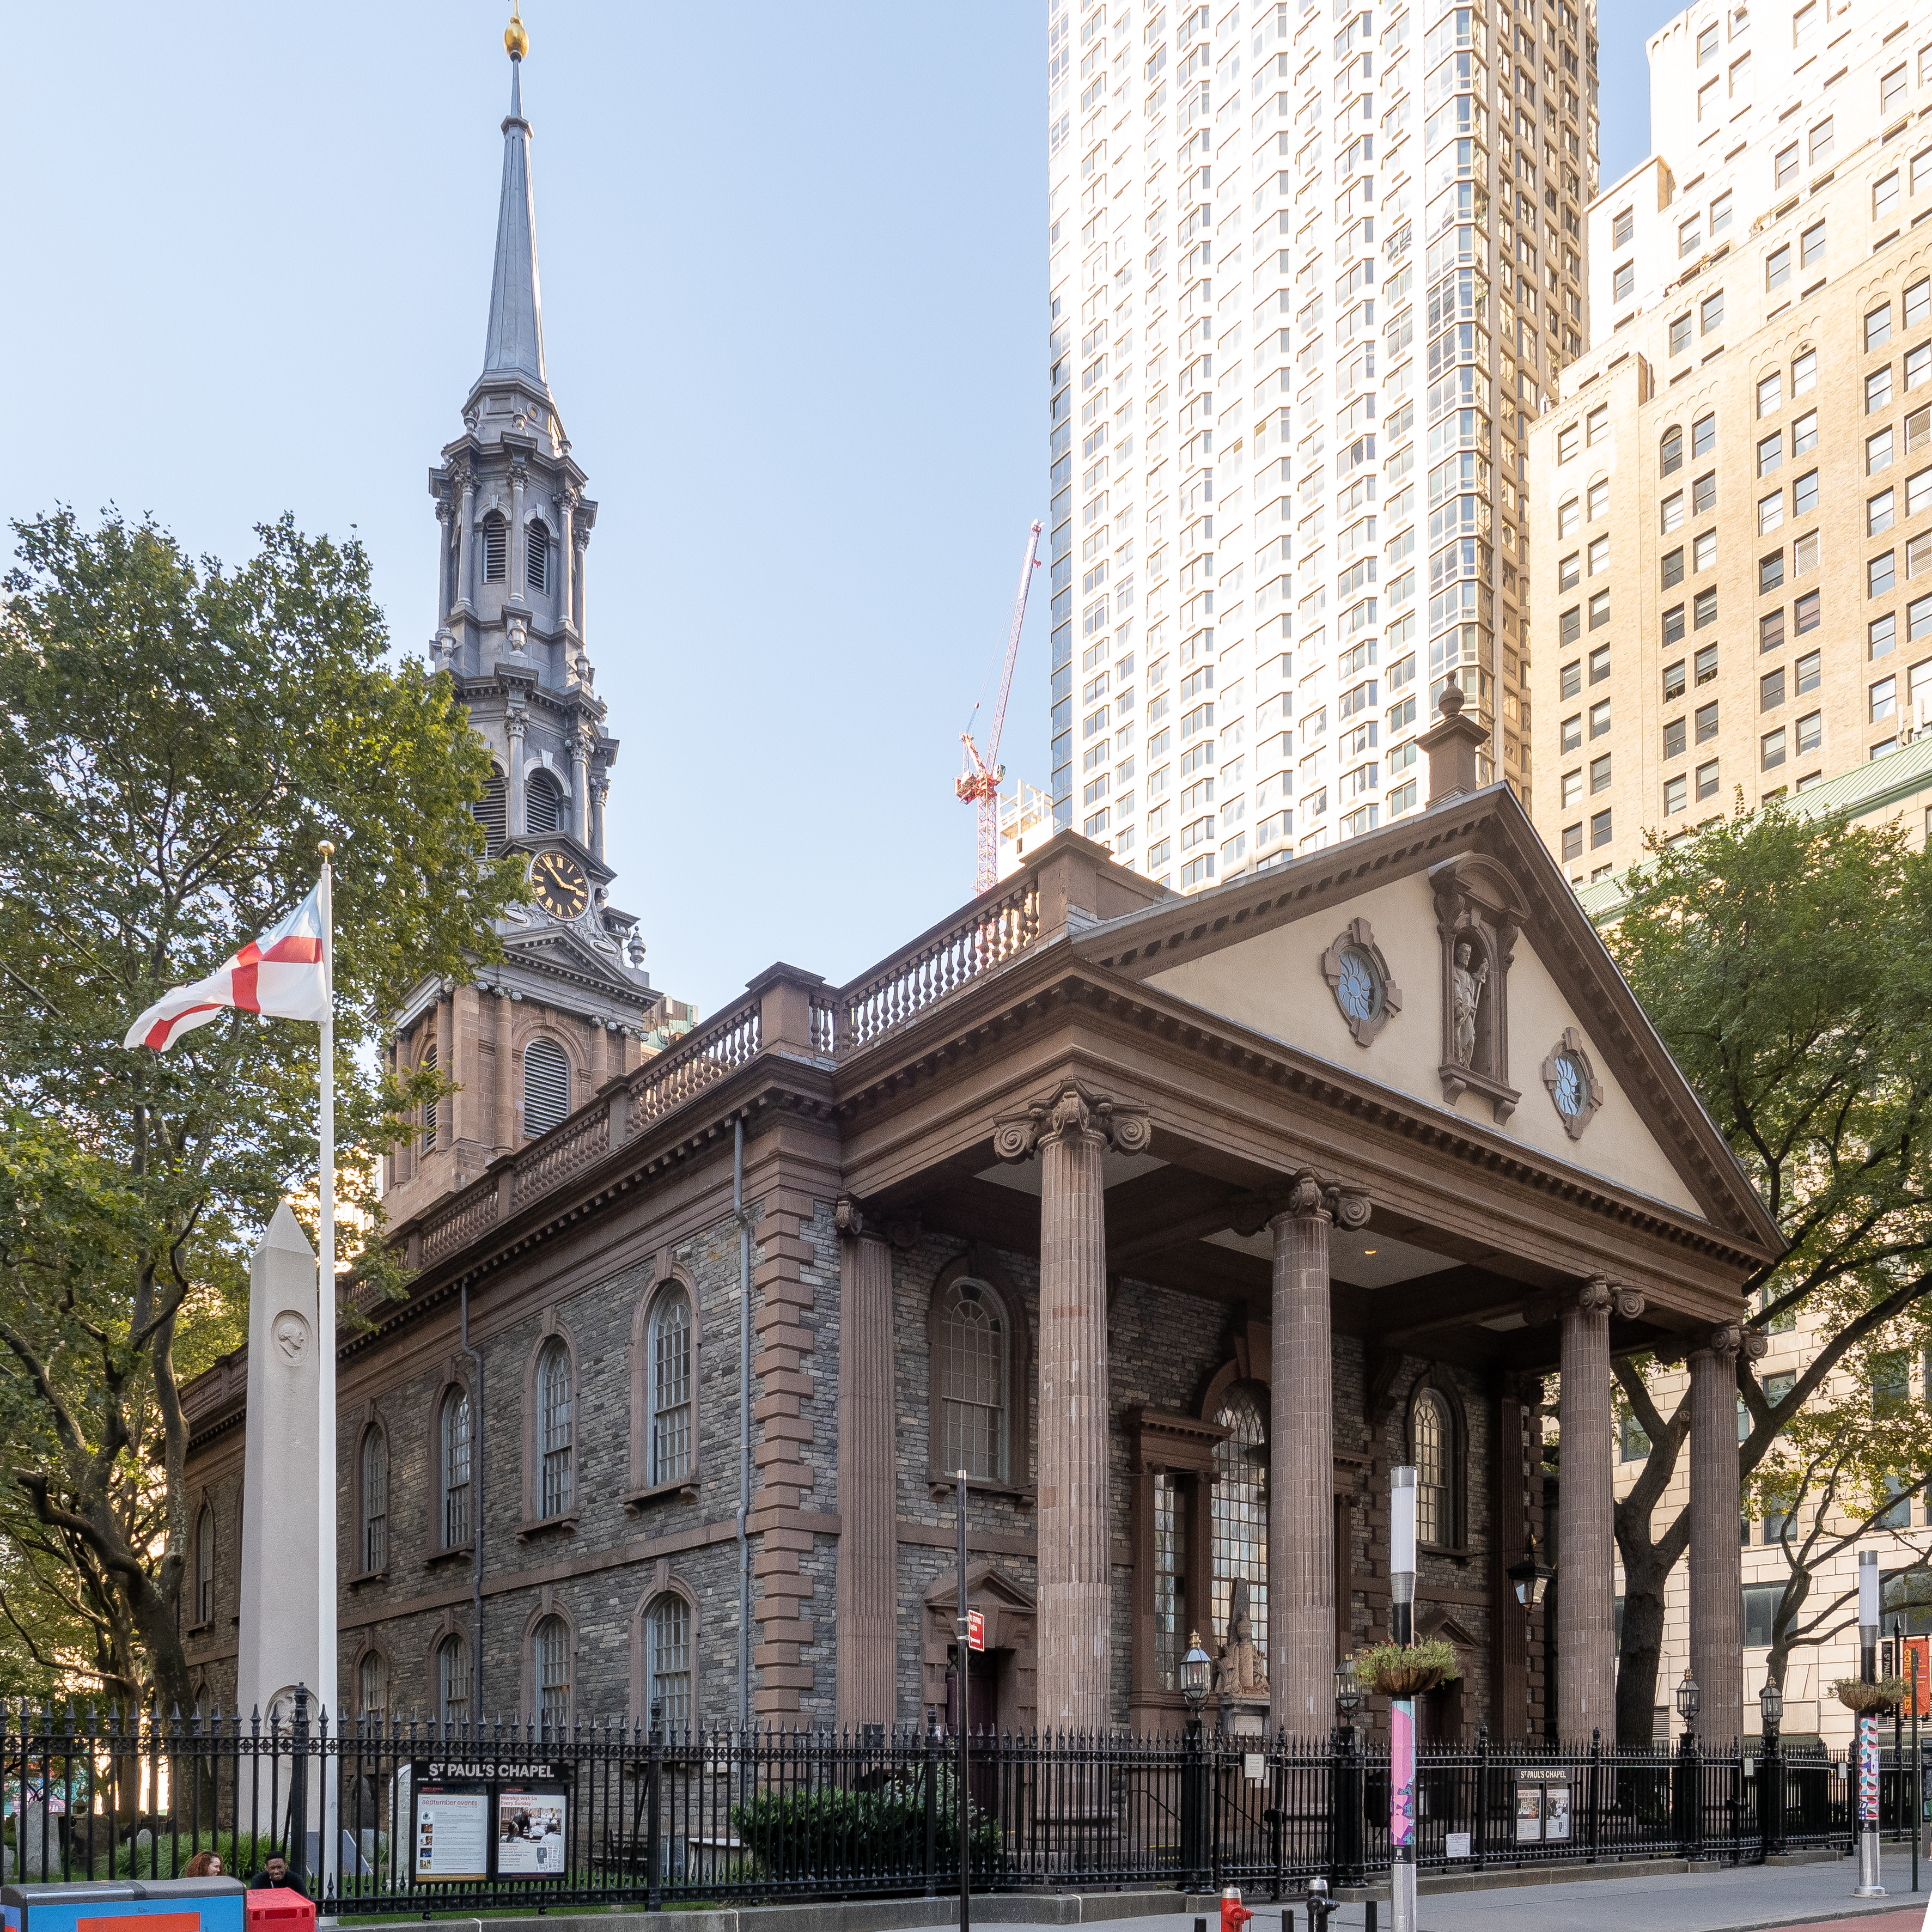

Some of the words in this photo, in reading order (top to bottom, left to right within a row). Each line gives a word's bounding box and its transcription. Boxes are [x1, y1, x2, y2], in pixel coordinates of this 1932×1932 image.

[1904, 1649, 1912, 1673] CORE
[448, 1764, 495, 1777] PAUL'S
[498, 1764, 554, 1777] CHAPEL
[1527, 1770, 1545, 1779] PAUL'S
[1545, 1770, 1567, 1778] CHAPEL
